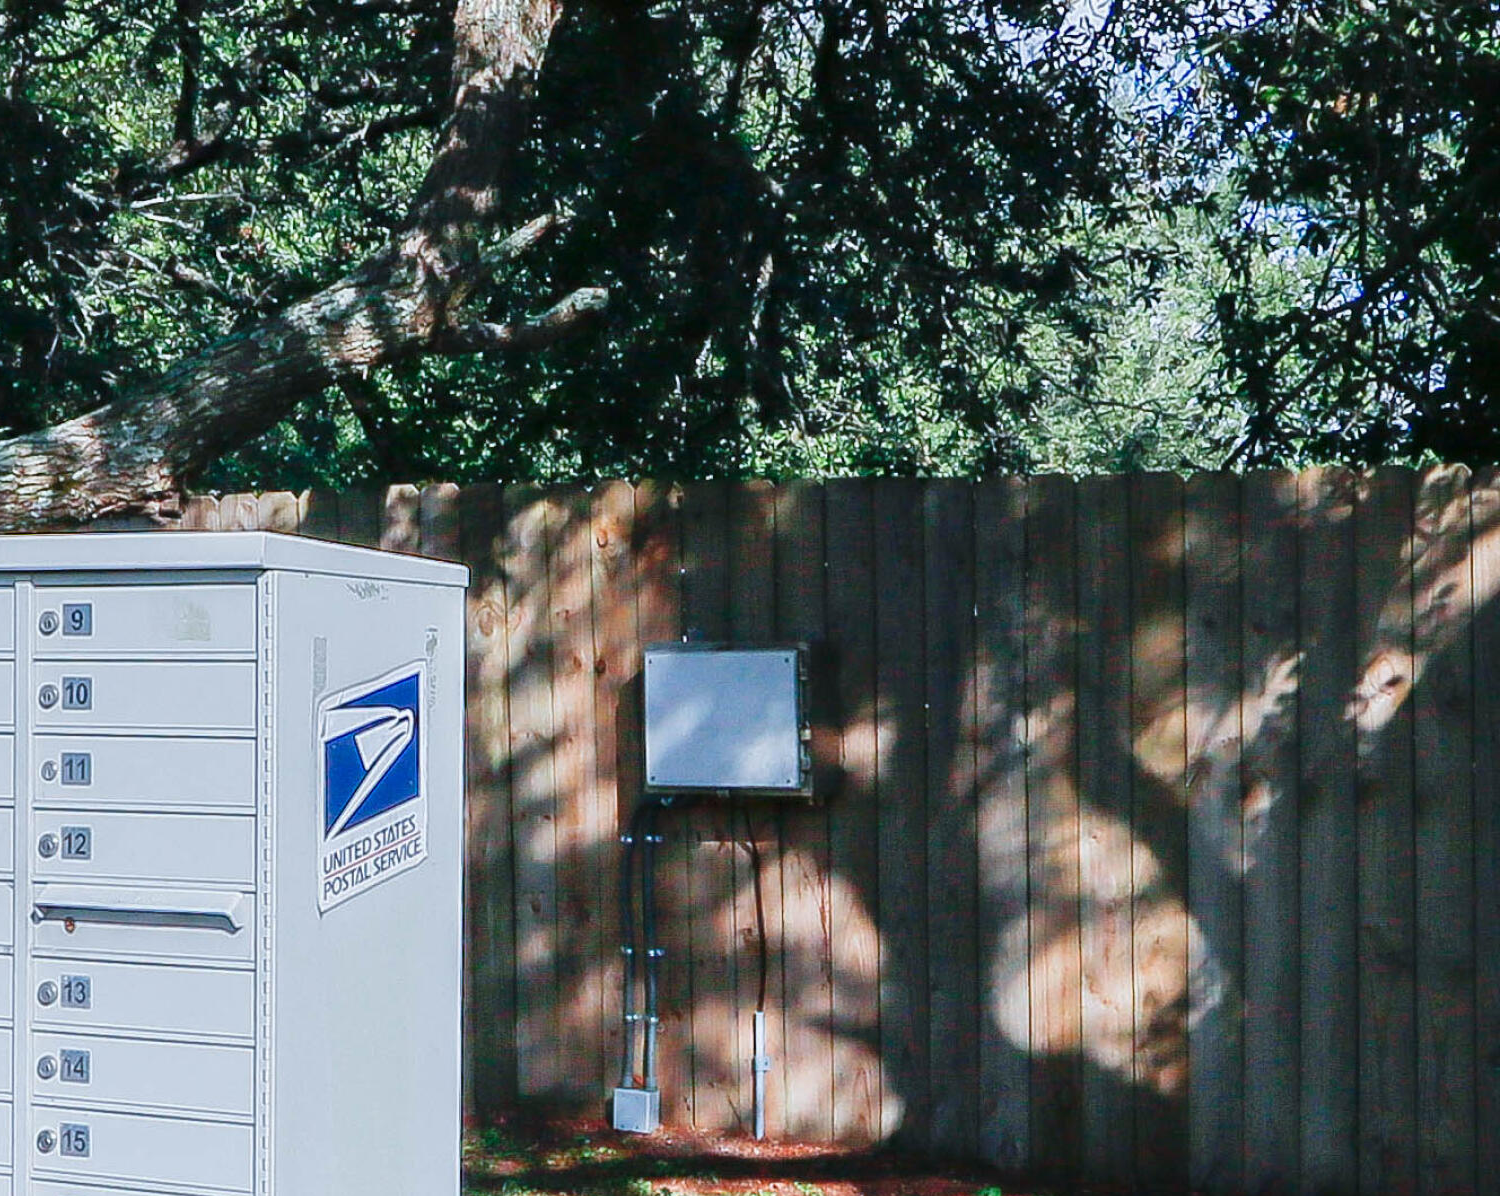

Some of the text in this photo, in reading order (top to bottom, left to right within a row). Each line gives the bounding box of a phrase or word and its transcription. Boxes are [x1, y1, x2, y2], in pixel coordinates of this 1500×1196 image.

[71, 609, 84, 631] 9
[65, 682, 88, 705] 10
[65, 758, 85, 780] 11
[64, 833, 86, 855] 12
[323, 814, 416, 874] UNITED STATES
[323, 836, 423, 901] POSTAL SERVICE
[64, 981, 86, 1004] 13
[63, 1056, 84, 1078] 14
[63, 1129, 86, 1152] 15
